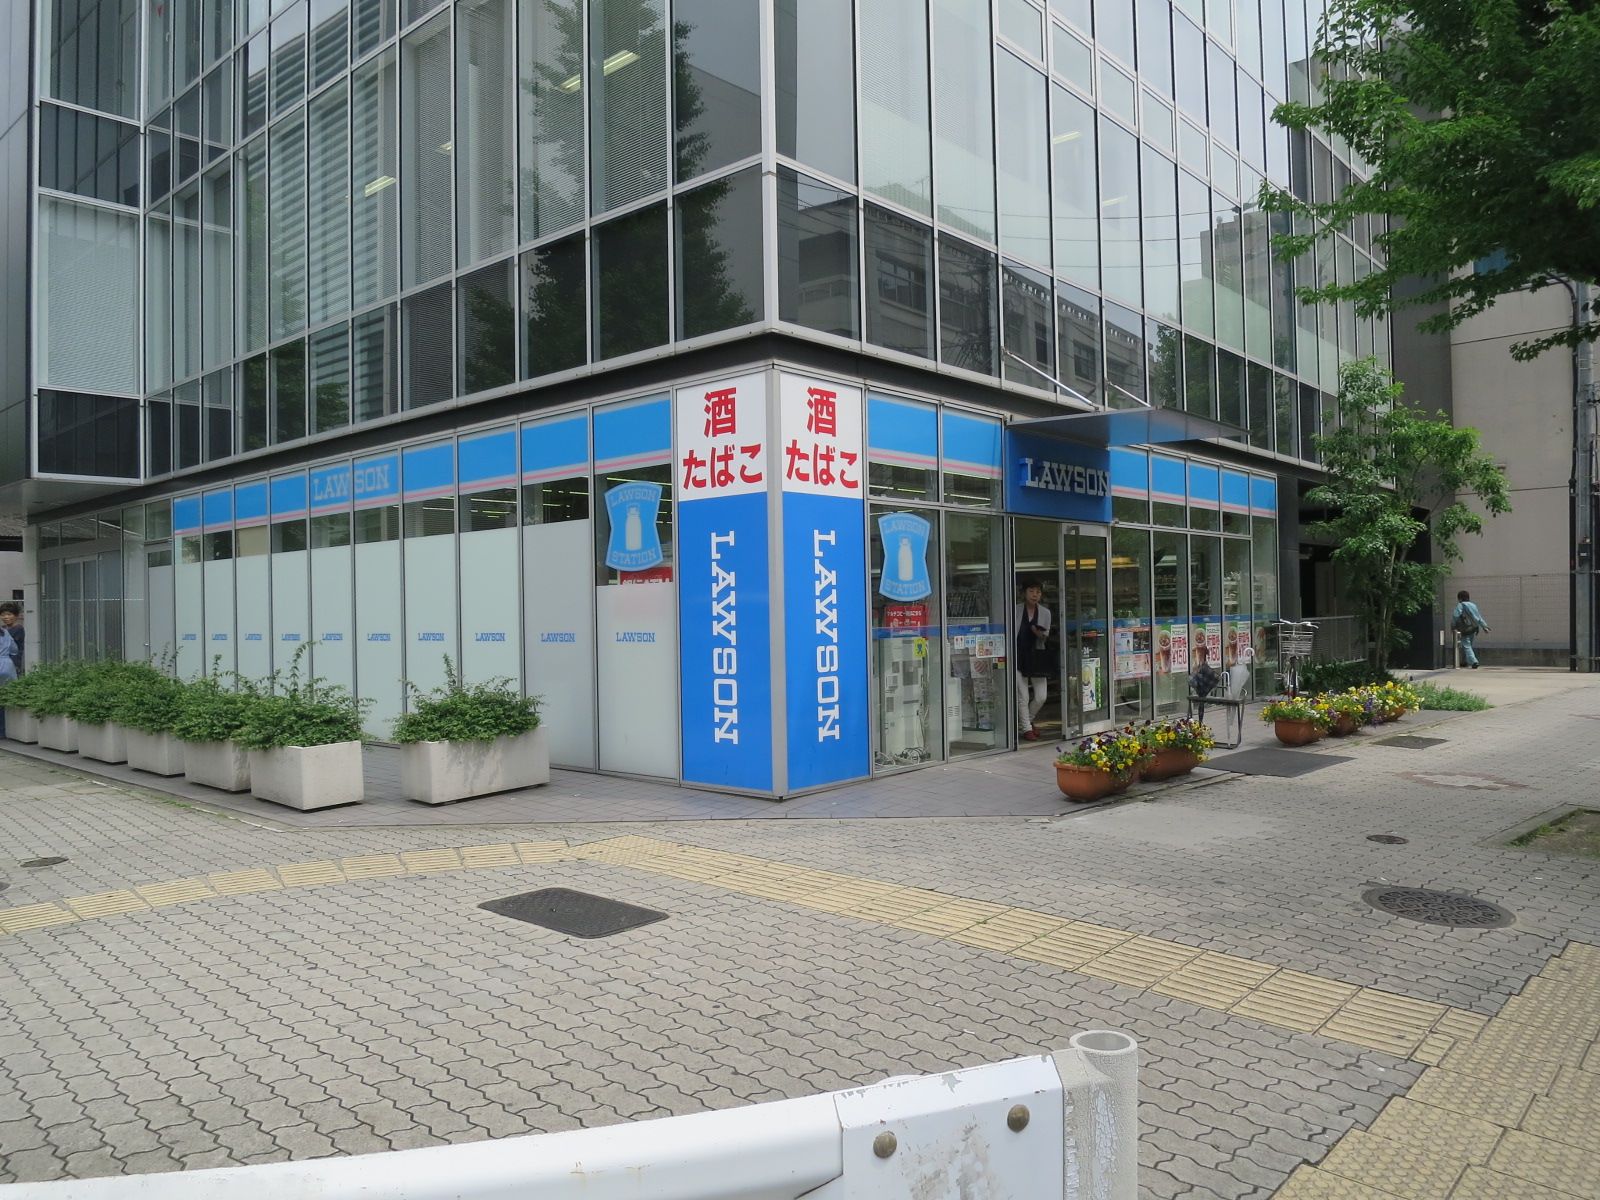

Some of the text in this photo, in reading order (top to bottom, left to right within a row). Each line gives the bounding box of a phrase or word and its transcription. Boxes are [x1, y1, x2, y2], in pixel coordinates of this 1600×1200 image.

[704, 387, 736, 437] 酒
[807, 386, 836, 437] 酒
[313, 464, 390, 500] LAWSON
[683, 443, 762, 489] たばこ
[786, 439, 858, 488] たばこ
[1025, 458, 1110, 496] LAWSON
[610, 488, 657, 507] LAWSON
[611, 548, 656, 564] STATION
[418, 633, 444, 641] LAWSON
[475, 633, 505, 642] LAWSON
[541, 633, 575, 642] LAWSON
[616, 632, 655, 642] LAWSON
[710, 530, 739, 744] LAWSON
[813, 529, 840, 742] LAWSON
